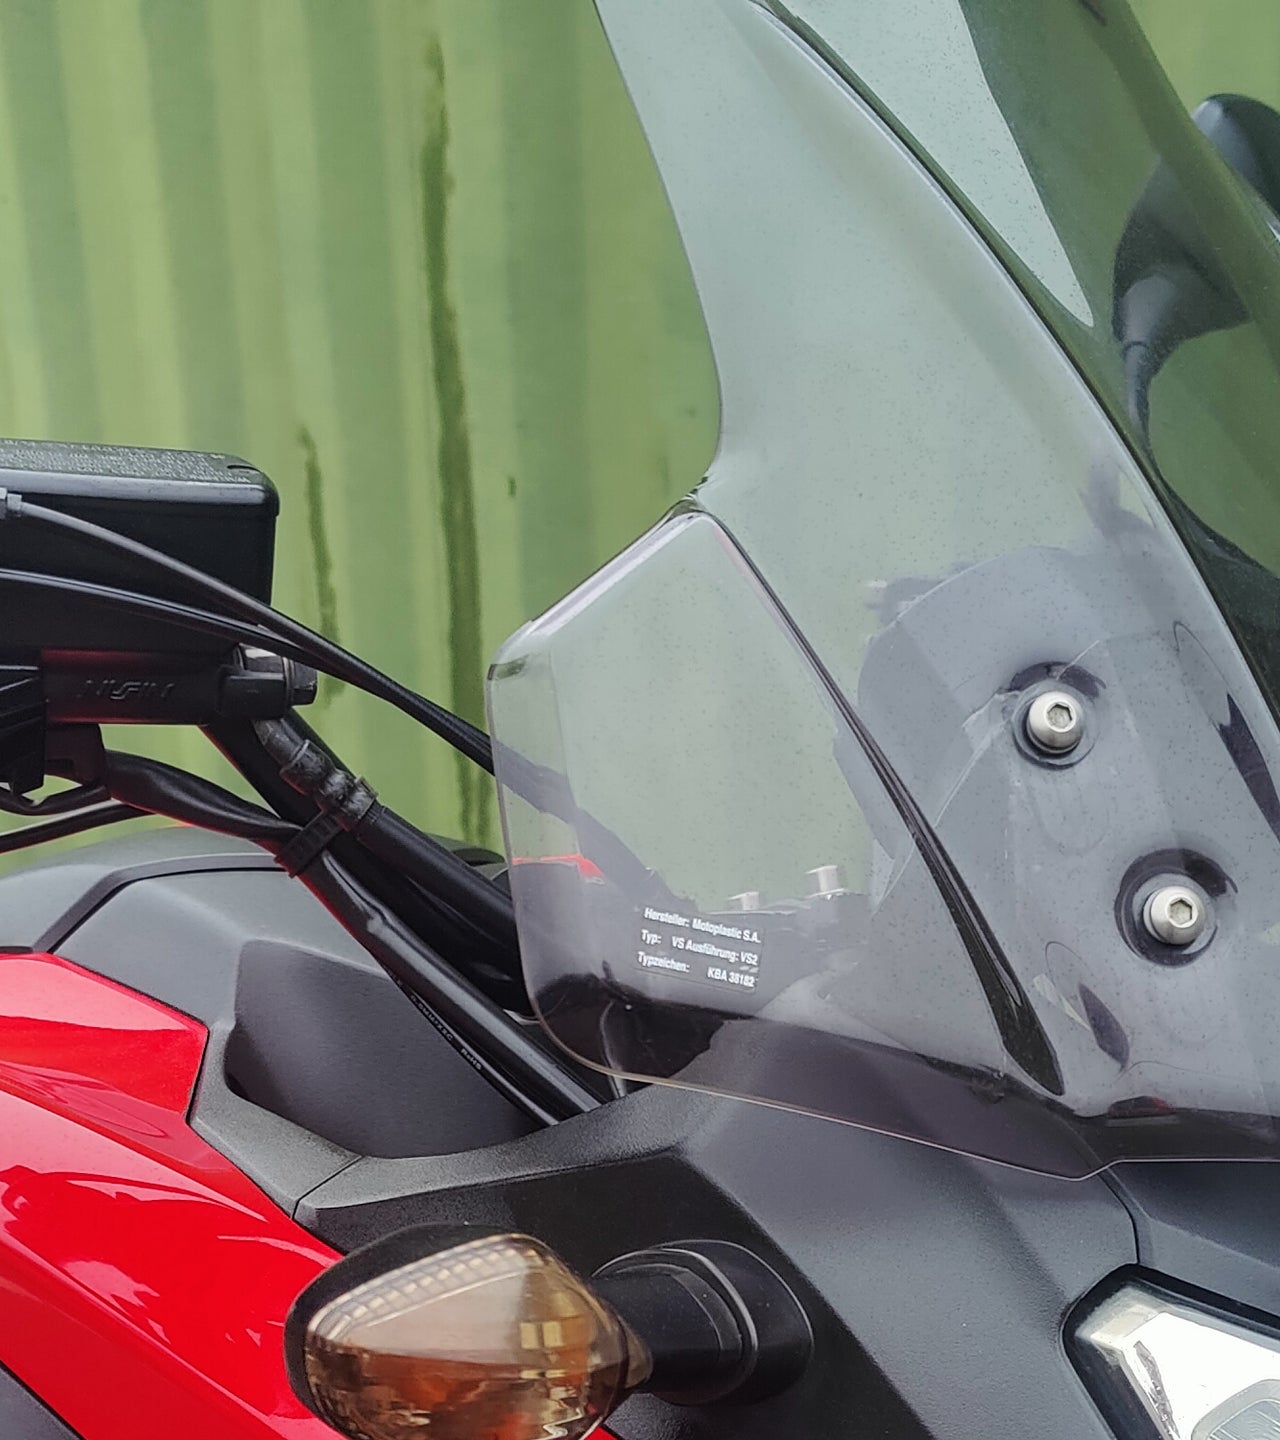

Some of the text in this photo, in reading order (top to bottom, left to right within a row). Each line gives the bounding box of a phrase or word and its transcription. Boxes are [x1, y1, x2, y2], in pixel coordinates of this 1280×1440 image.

[644, 907, 761, 943] Hersteller: Motoplastic S.A.
[641, 929, 662, 945] Typ:
[685, 940, 740, 963] Ausführung:
[740, 951, 759, 966] VS2
[637, 951, 691, 973] Typzeichen:
[707, 966, 728, 982] KBA
